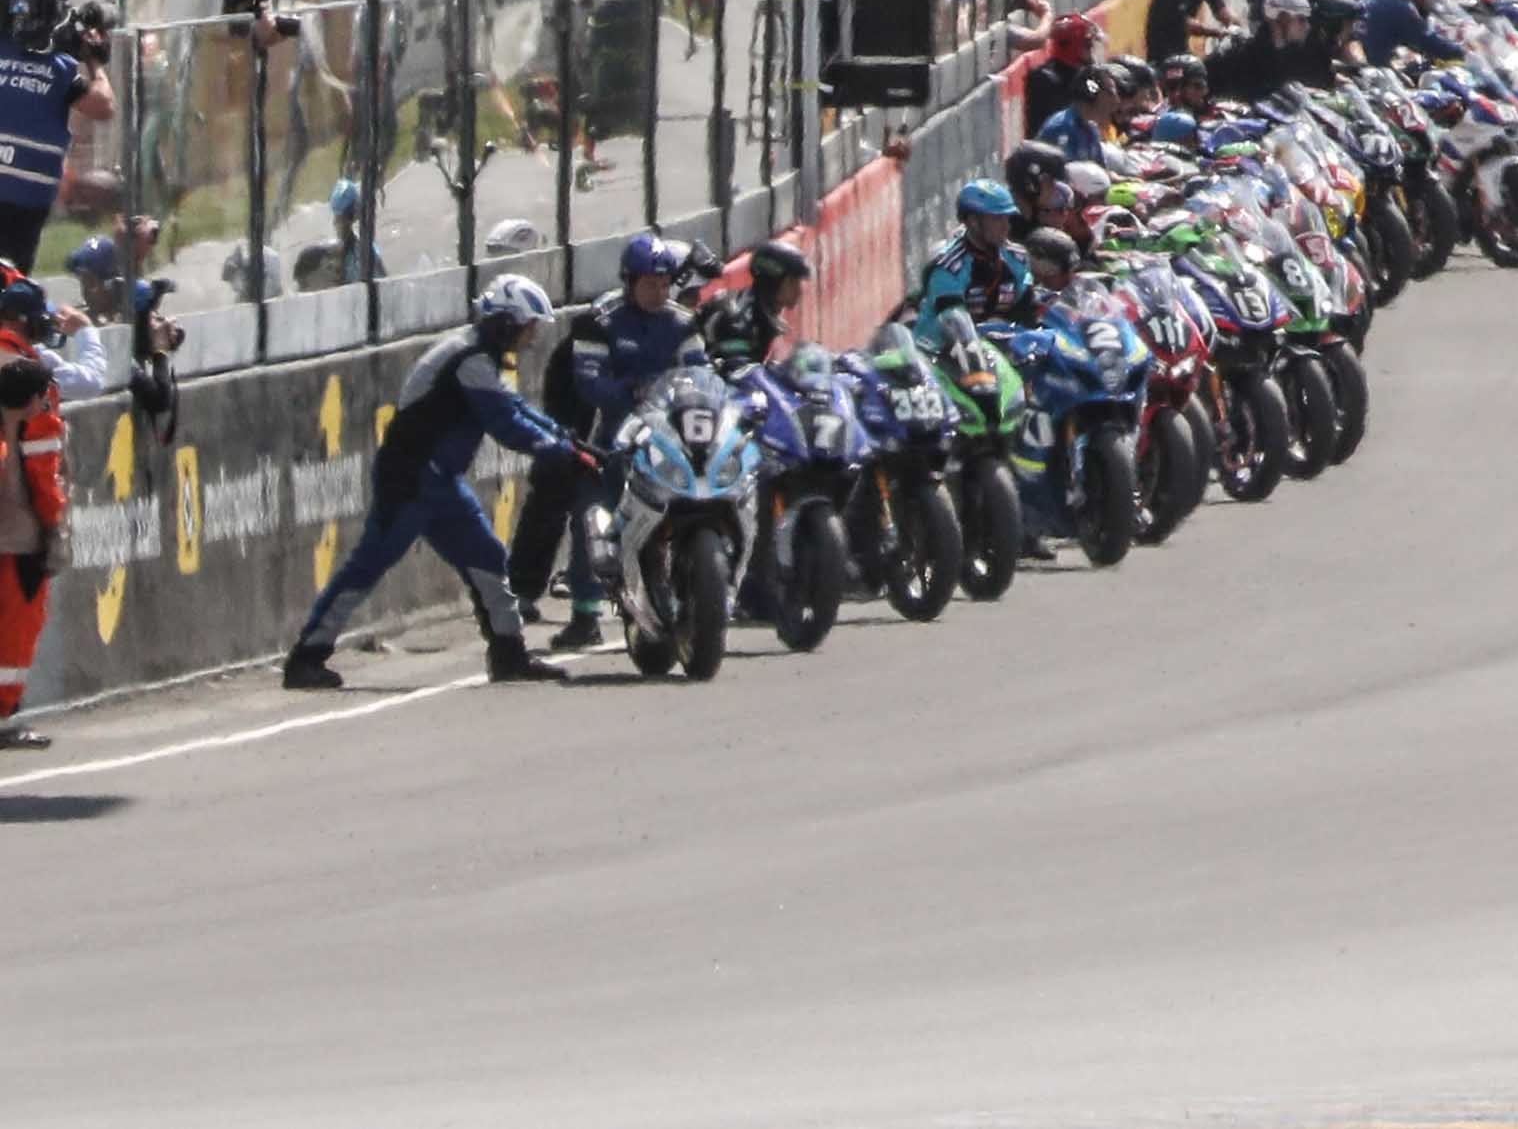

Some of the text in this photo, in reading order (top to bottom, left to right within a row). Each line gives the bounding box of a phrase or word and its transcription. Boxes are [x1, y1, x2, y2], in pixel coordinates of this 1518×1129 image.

[1087, 322, 1123, 350] 2
[680, 408, 716, 445] 6
[813, 413, 844, 458] 7
